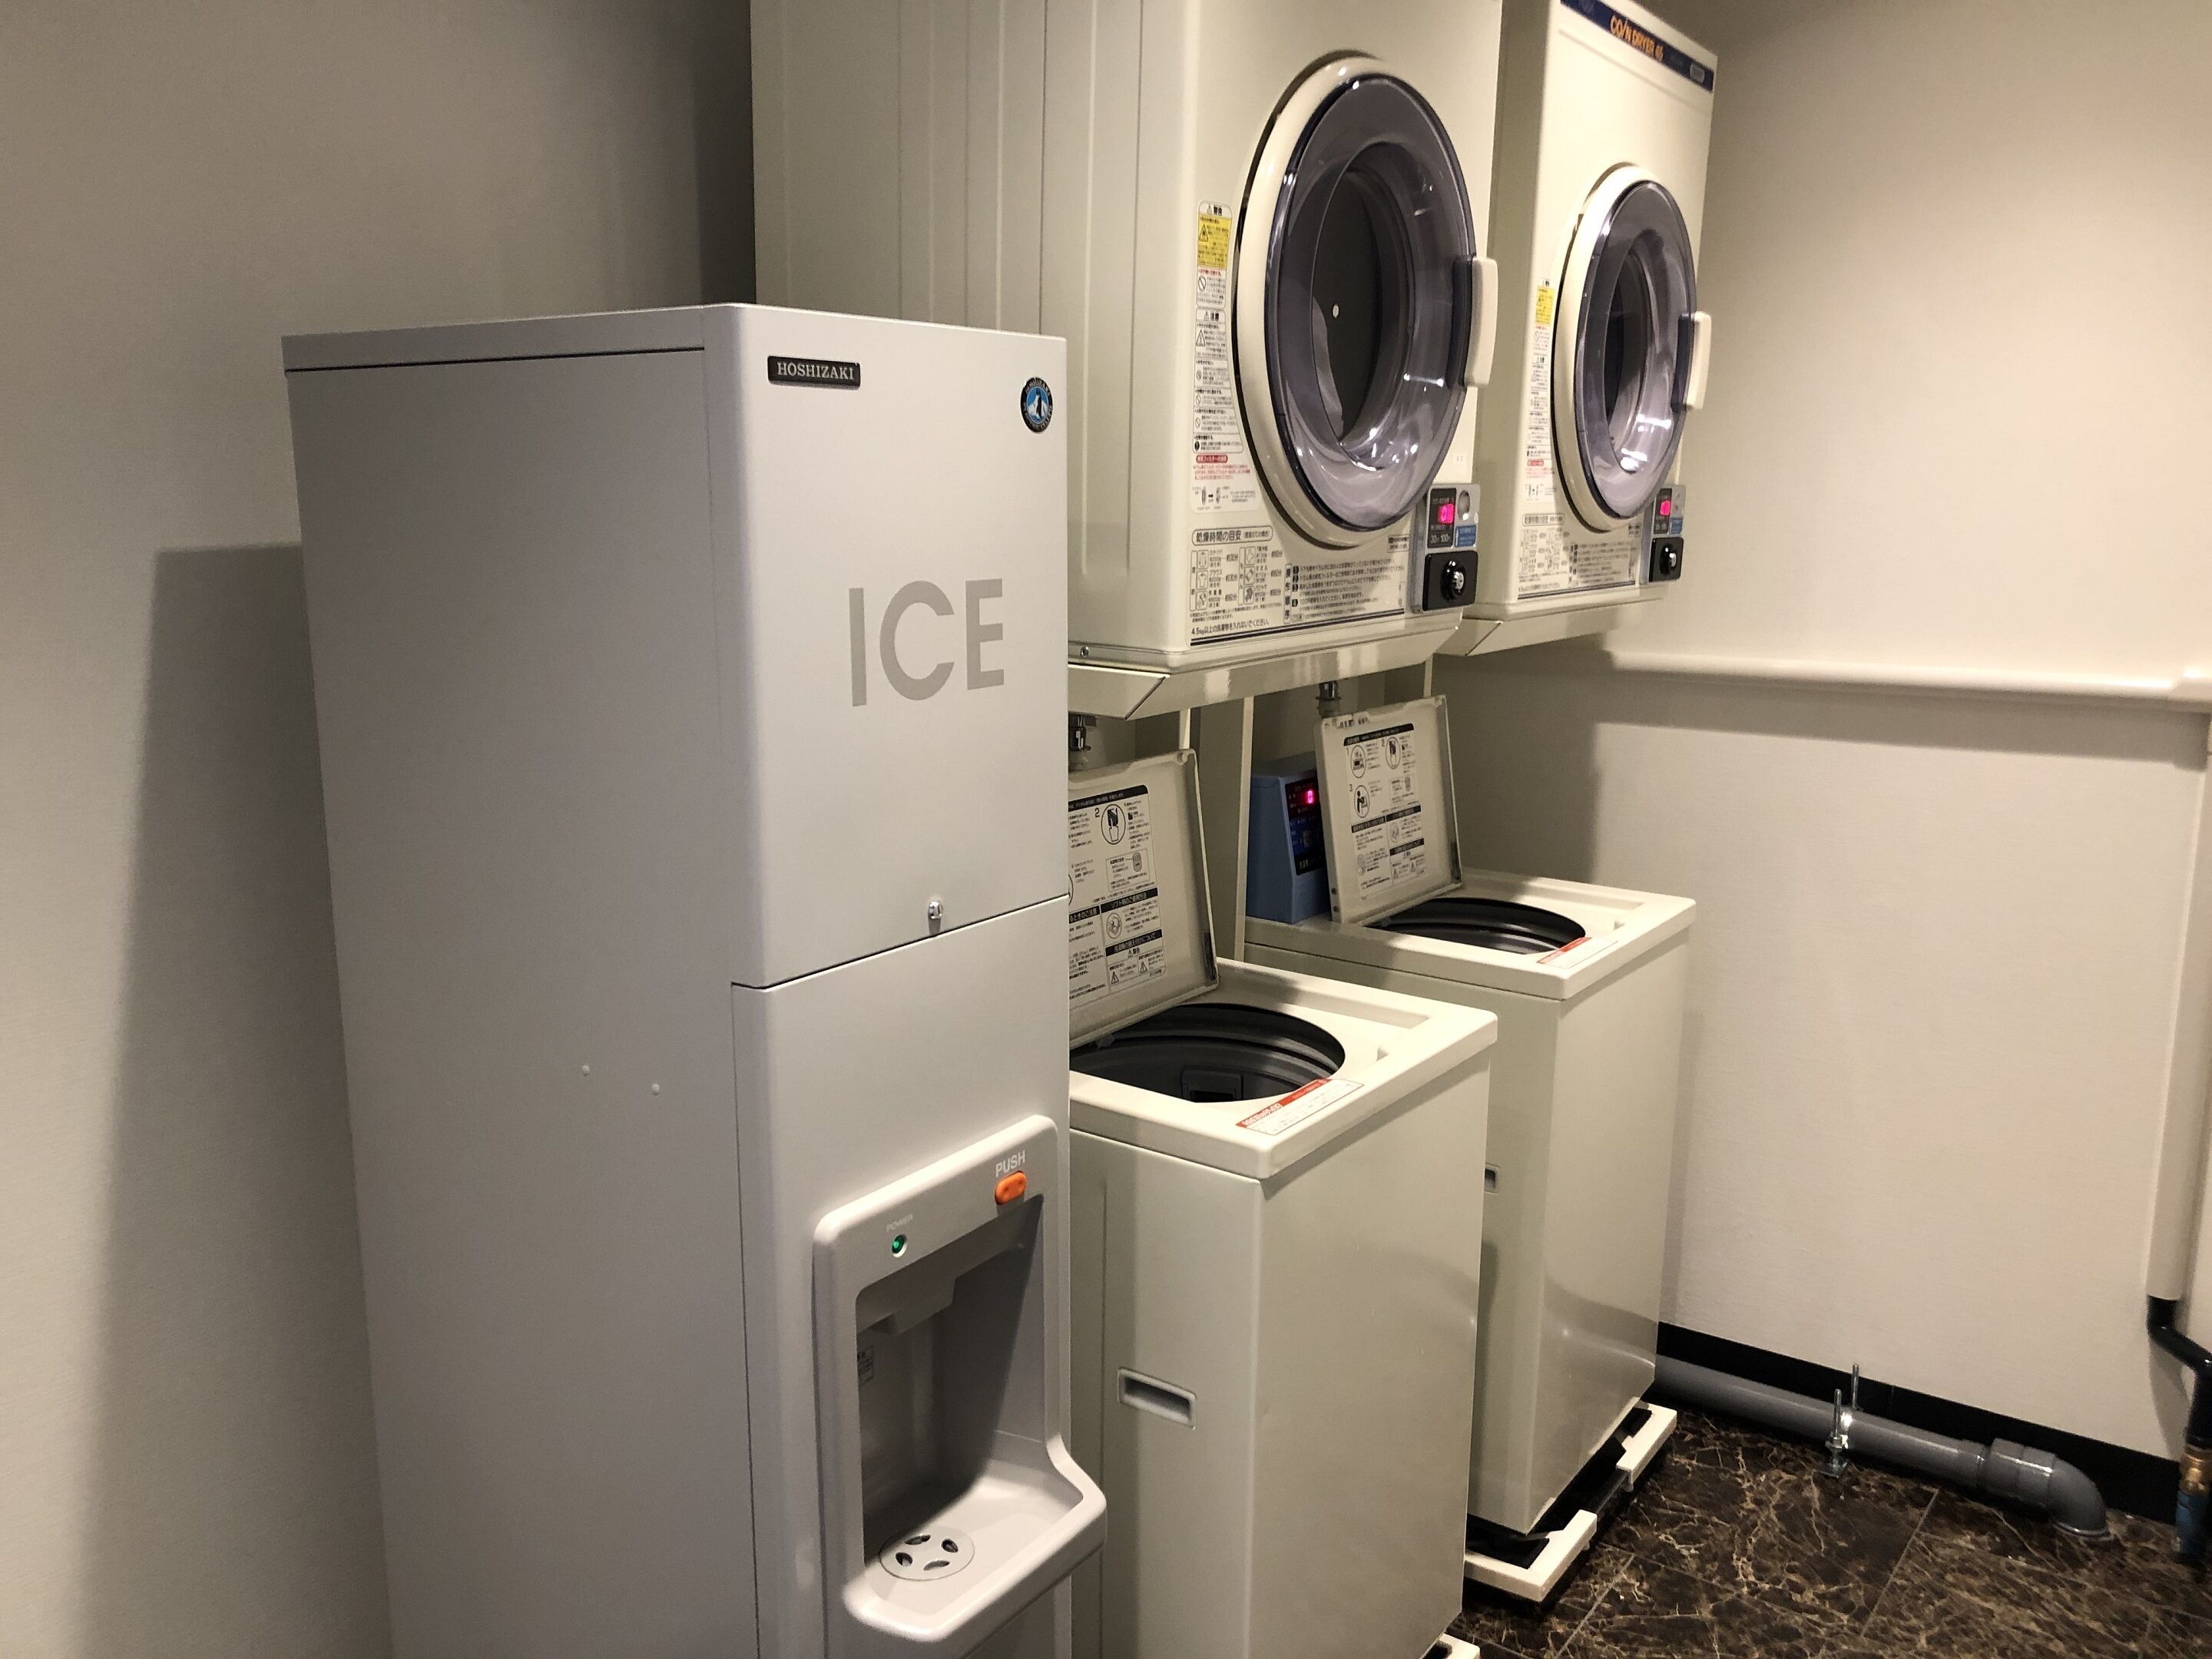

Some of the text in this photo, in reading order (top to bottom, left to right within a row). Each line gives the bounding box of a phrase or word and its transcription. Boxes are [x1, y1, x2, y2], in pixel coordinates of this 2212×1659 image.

[777, 361, 855, 381] HOSHIZAKI
[849, 578, 1005, 707] ICE
[1094, 807, 1101, 818] 2
[995, 1149, 1026, 1178] PUSH
